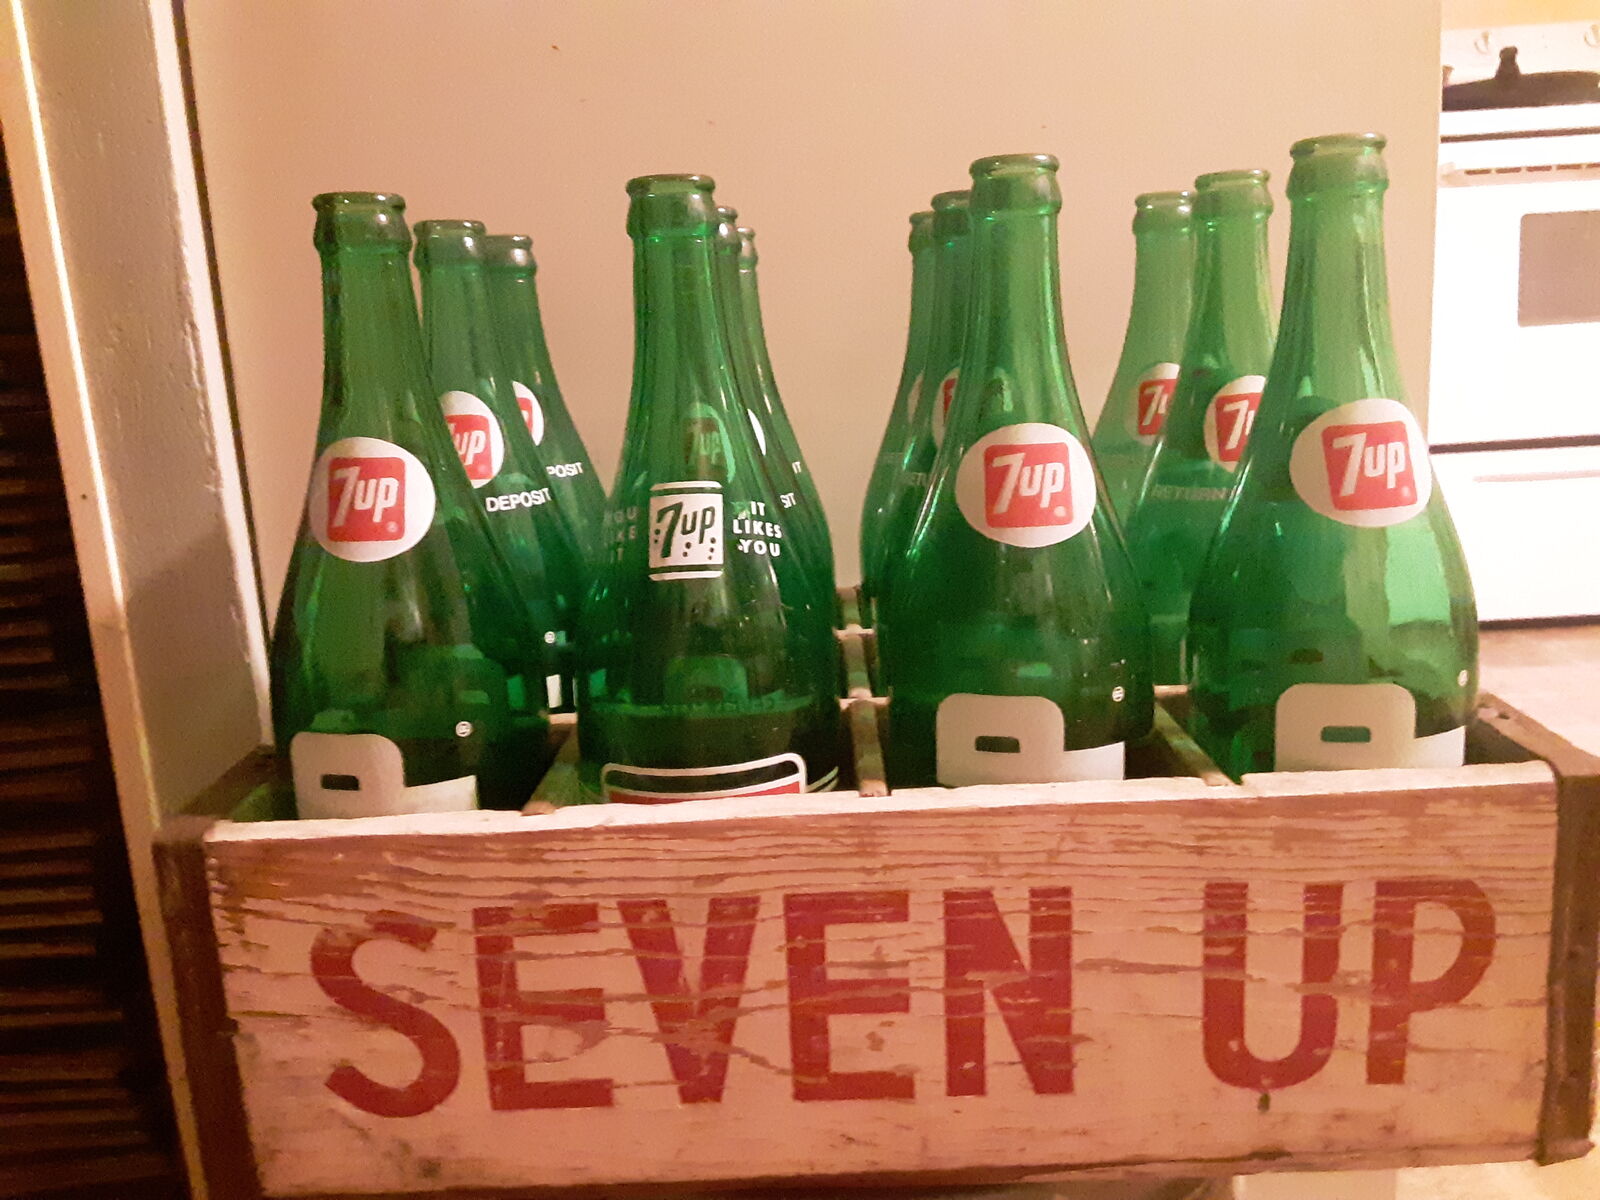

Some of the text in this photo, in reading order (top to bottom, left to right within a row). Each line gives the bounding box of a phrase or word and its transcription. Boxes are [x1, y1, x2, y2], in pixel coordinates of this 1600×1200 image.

[486, 488, 552, 512] DEPOSIT
[750, 501, 766, 516] IT
[733, 519, 783, 539] LIKES
[739, 539, 781, 557] YOU
[311, 879, 1496, 1118] SEVEN UP
